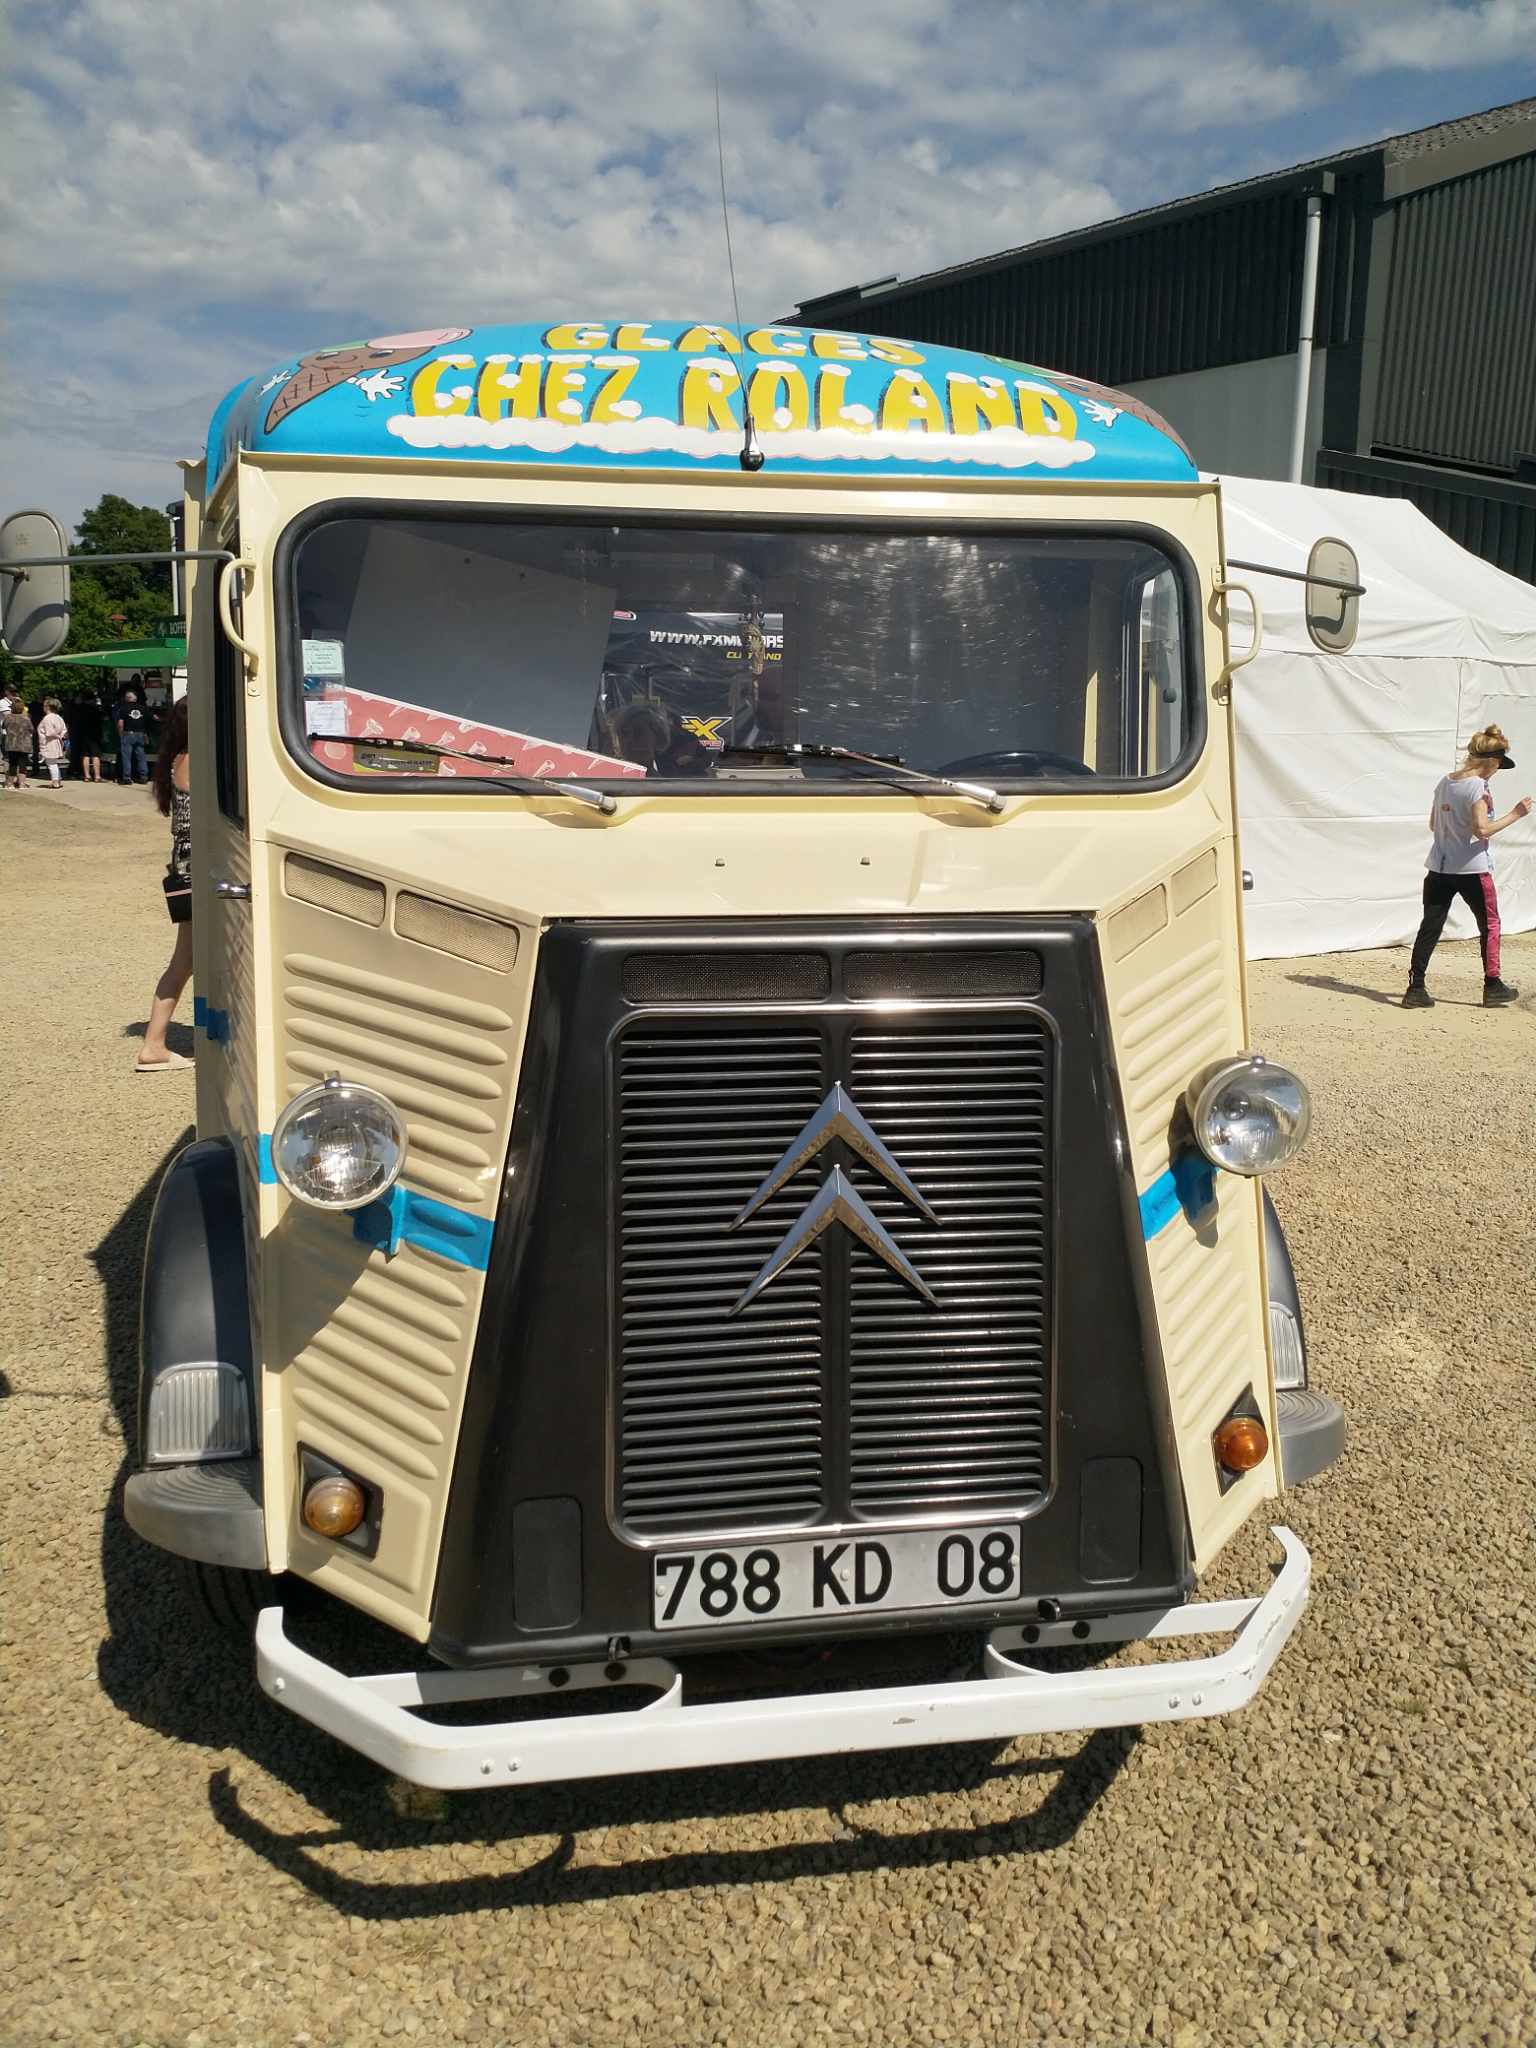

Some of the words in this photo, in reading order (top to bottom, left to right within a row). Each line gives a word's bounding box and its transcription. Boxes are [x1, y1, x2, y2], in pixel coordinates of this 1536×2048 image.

[544, 321, 927, 366] GLACES
[408, 353, 643, 427] CHEZ
[678, 357, 1078, 441] ROLAND
[656, 1548, 781, 1622] 788
[812, 1541, 893, 1609] KD
[936, 1531, 1015, 1598] 08
